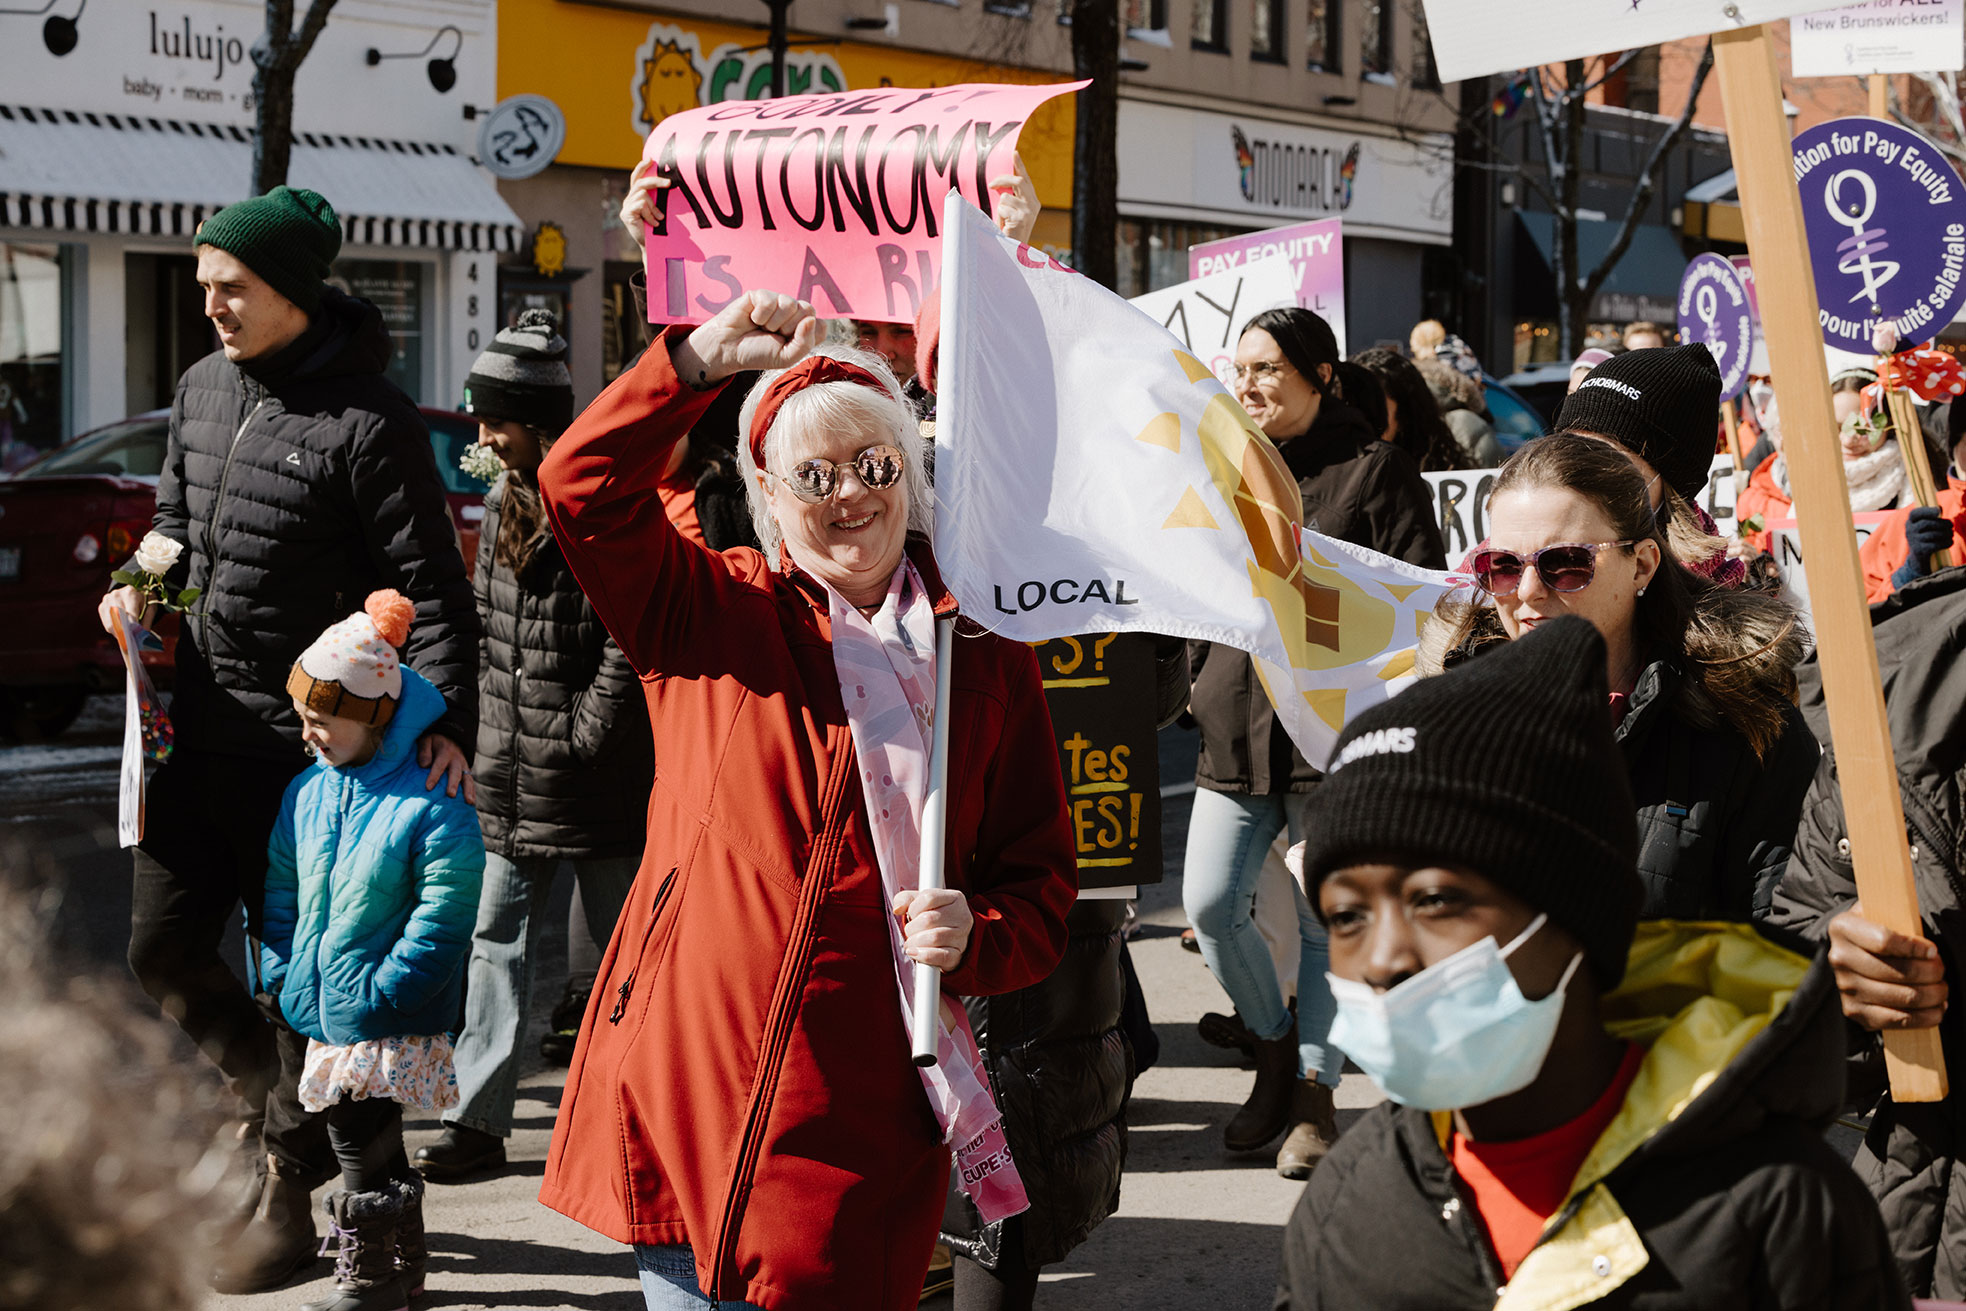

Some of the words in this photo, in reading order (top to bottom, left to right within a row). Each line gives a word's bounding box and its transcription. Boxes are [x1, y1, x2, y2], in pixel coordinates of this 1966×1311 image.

[150, 11, 243, 80] lulujo
[1804, 17, 1836, 31] New
[1840, 11, 1949, 30] Brunswickers!
[123, 75, 162, 101] baby
[183, 86, 224, 103] mom
[652, 119, 1023, 238] AUTONOMY
[1831, 131, 1861, 156] for
[1863, 130, 1902, 166] Pay
[1899, 145, 1954, 206] Equity
[665, 252, 745, 317] IS
[799, 244, 855, 315] A
[1197, 248, 1243, 278] PAY
[1818, 308, 1861, 341] pour
[1928, 222, 1966, 310] salariale
[993, 578, 1139, 615] LOCAL
[1063, 731, 1131, 785] tes
[1067, 793, 1143, 852] ES!
